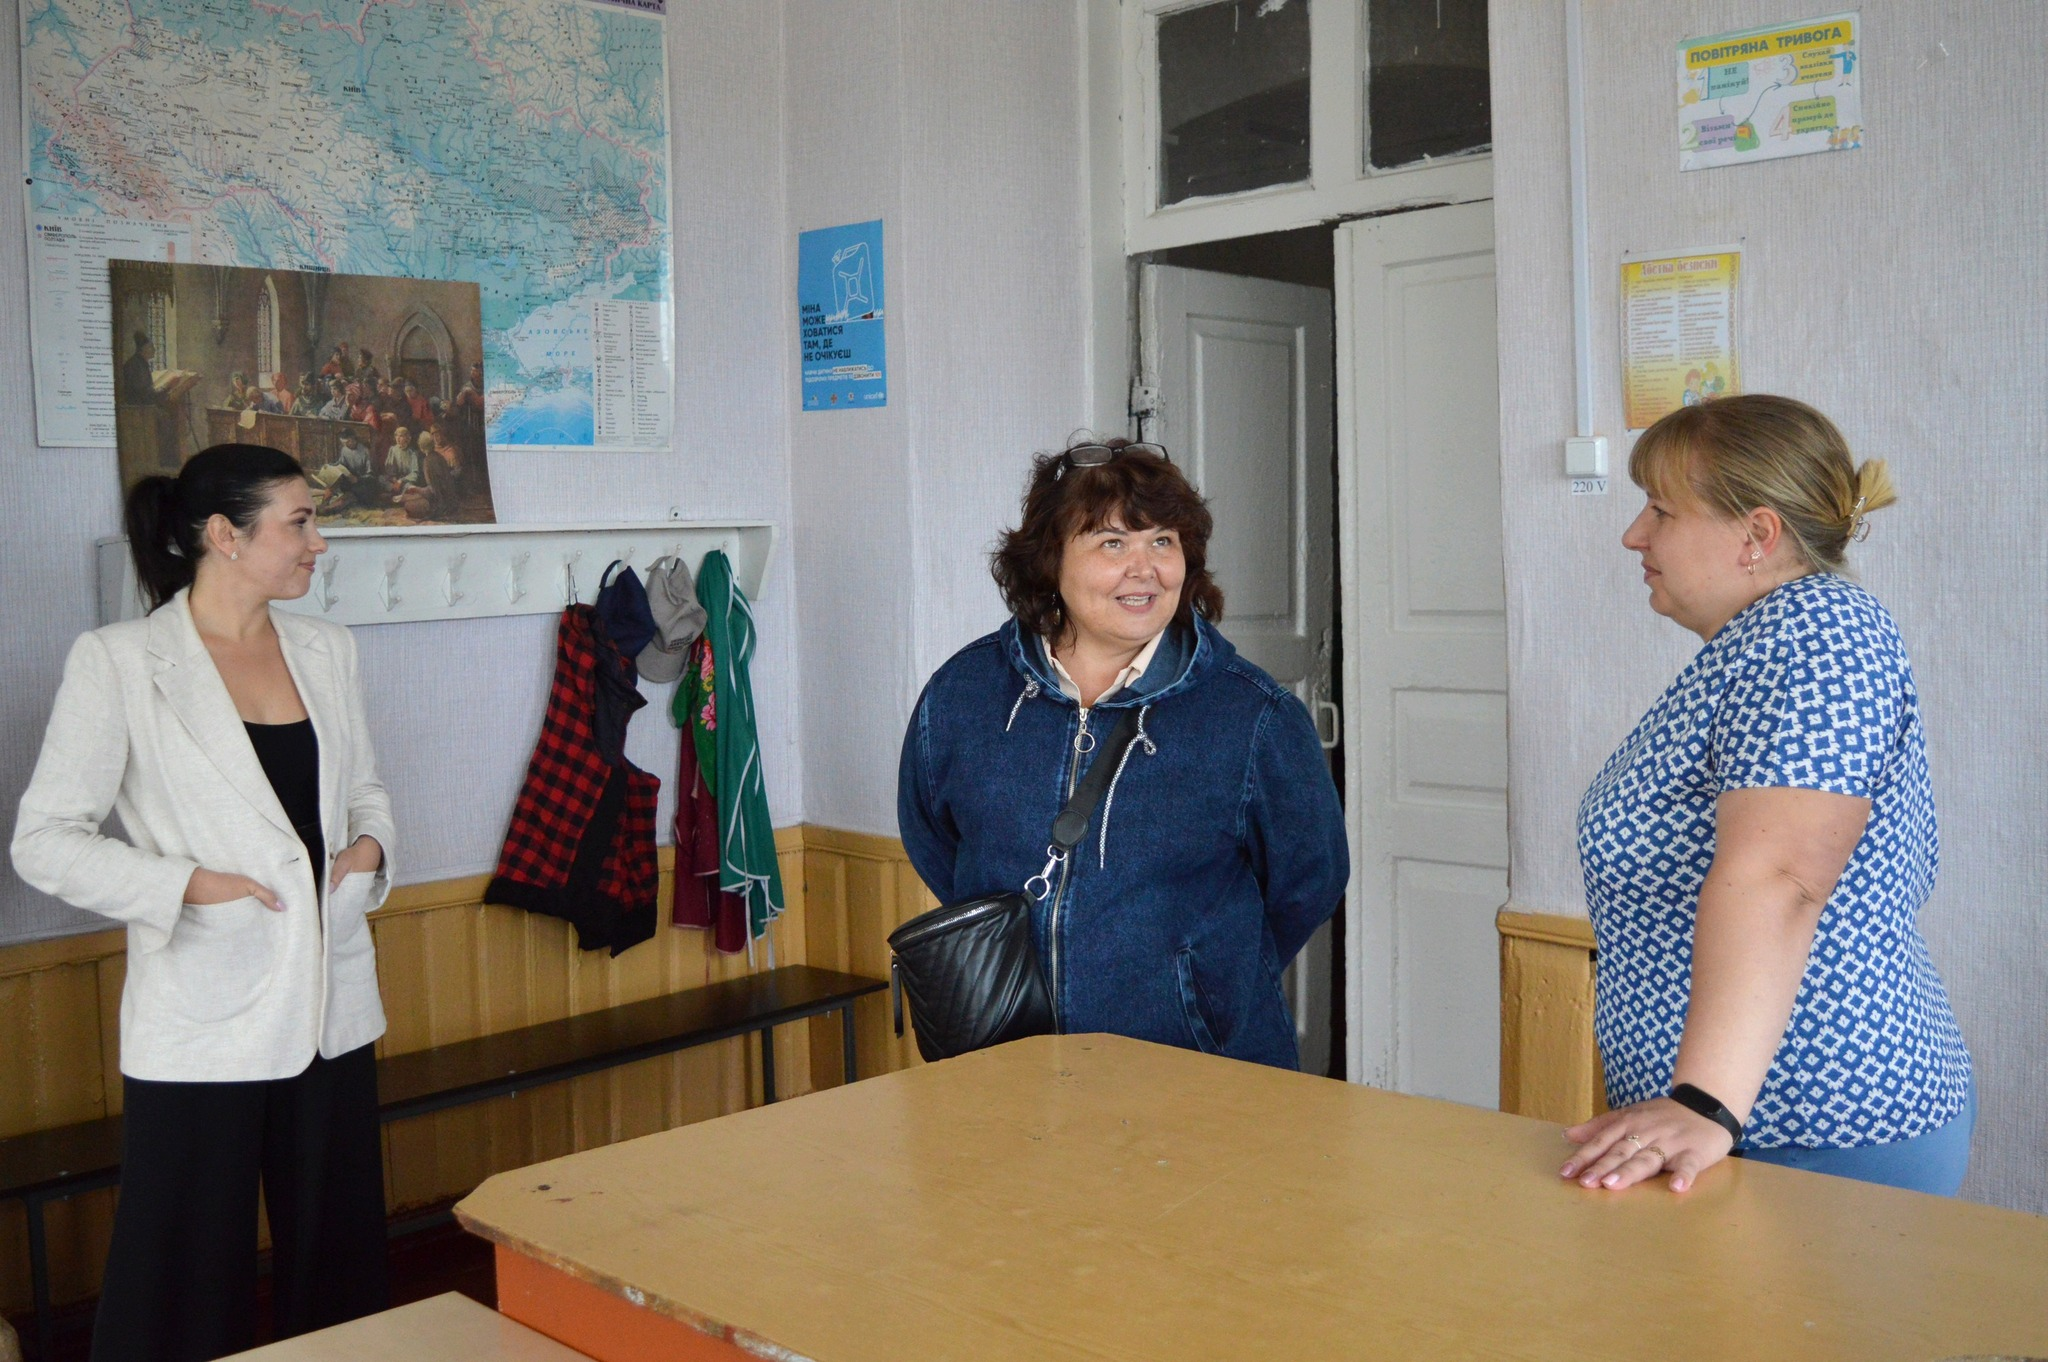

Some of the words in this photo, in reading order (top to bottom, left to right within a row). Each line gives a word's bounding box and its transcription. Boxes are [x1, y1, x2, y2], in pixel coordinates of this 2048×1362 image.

[1690, 40, 1769, 64] ПОВІТРЯНА
[1776, 26, 1842, 49] ТРИВОГА
[1724, 67, 1737, 76] НЕ
[802, 303, 821, 314] МІНА
[802, 315, 826, 326] МОЖЕ
[803, 326, 843, 338] ХОВАТИСЯ
[804, 340, 821, 350] ТАМ,
[823, 338, 833, 349] ДЕ
[804, 352, 813, 361] НЕ
[815, 349, 851, 361] ОЧІКУЄШ
[1573, 481, 1593, 493] 220
[1597, 480, 1606, 492] V
